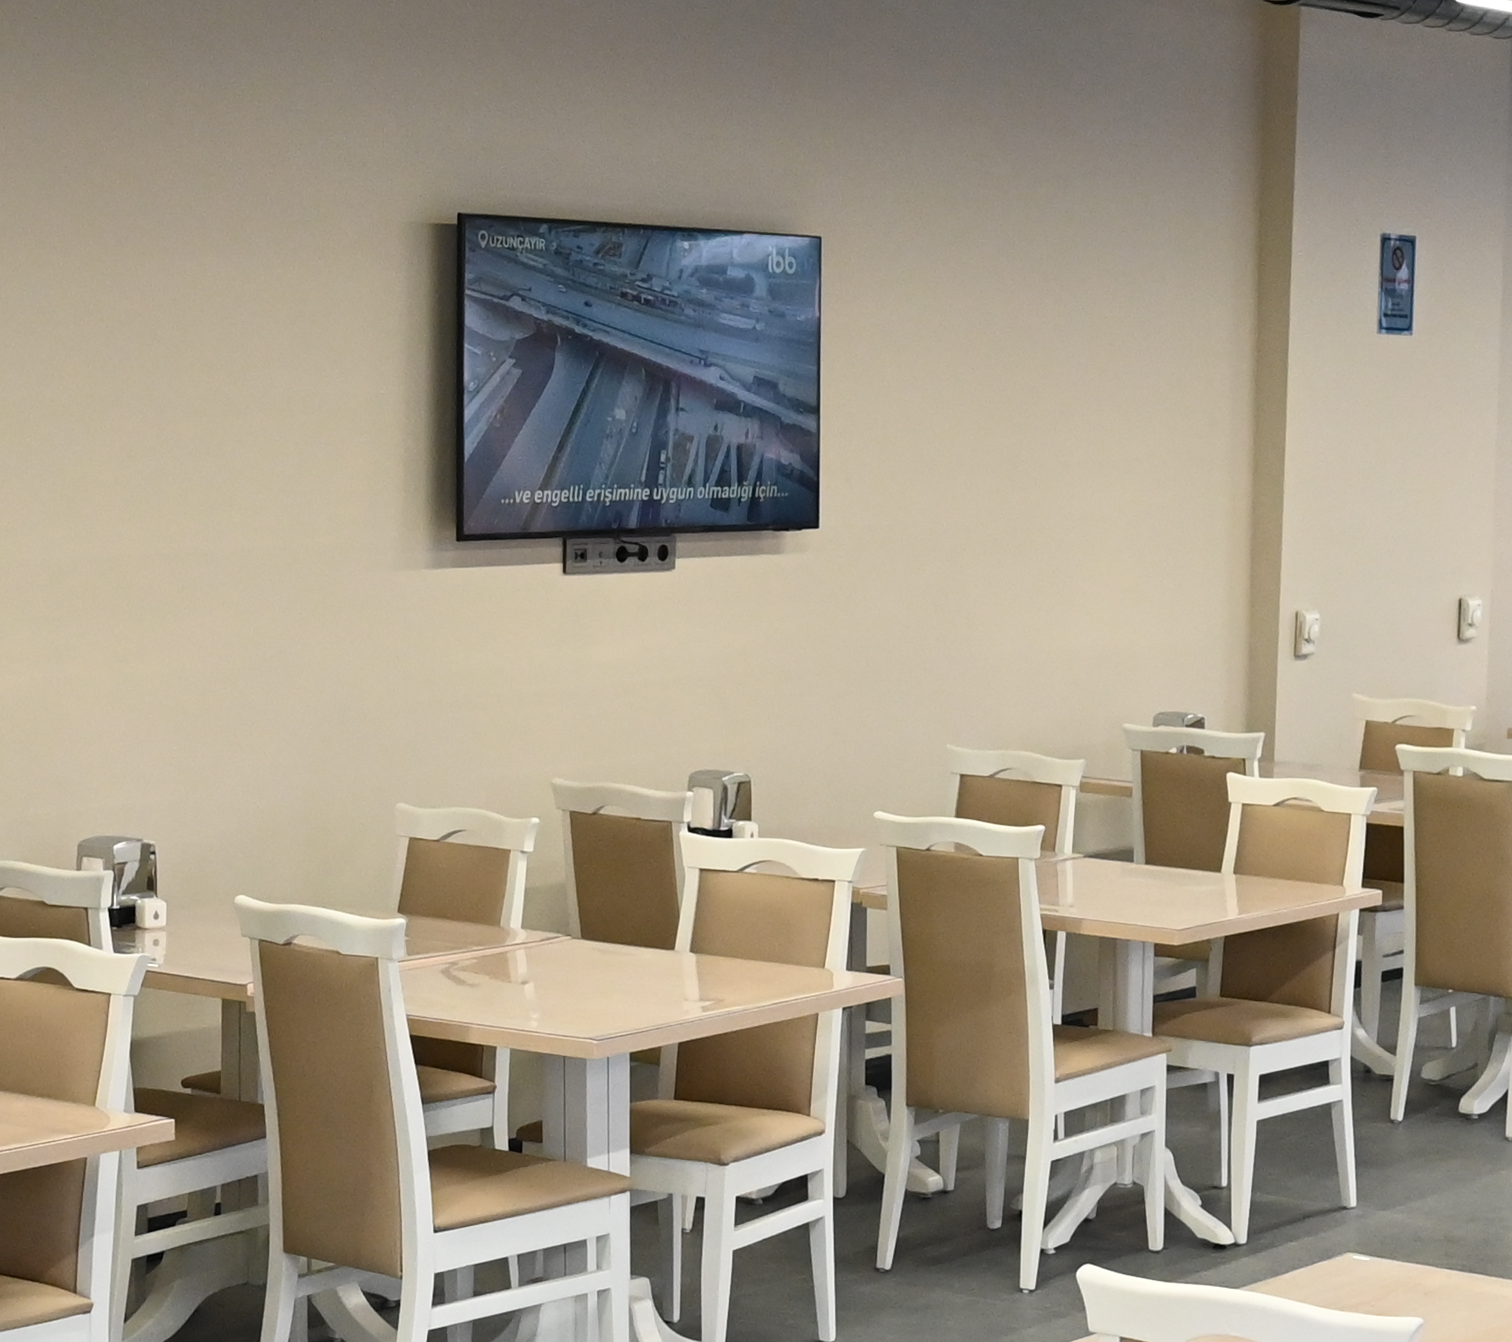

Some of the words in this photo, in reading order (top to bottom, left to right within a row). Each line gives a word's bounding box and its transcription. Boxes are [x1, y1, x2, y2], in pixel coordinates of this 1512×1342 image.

[489, 235, 547, 253] UZUNÇAYIR
[534, 484, 584, 506] engelli
[586, 484, 650, 505] erişimine
[653, 487, 694, 504] uygun
[697, 481, 752, 502] olmadığı
